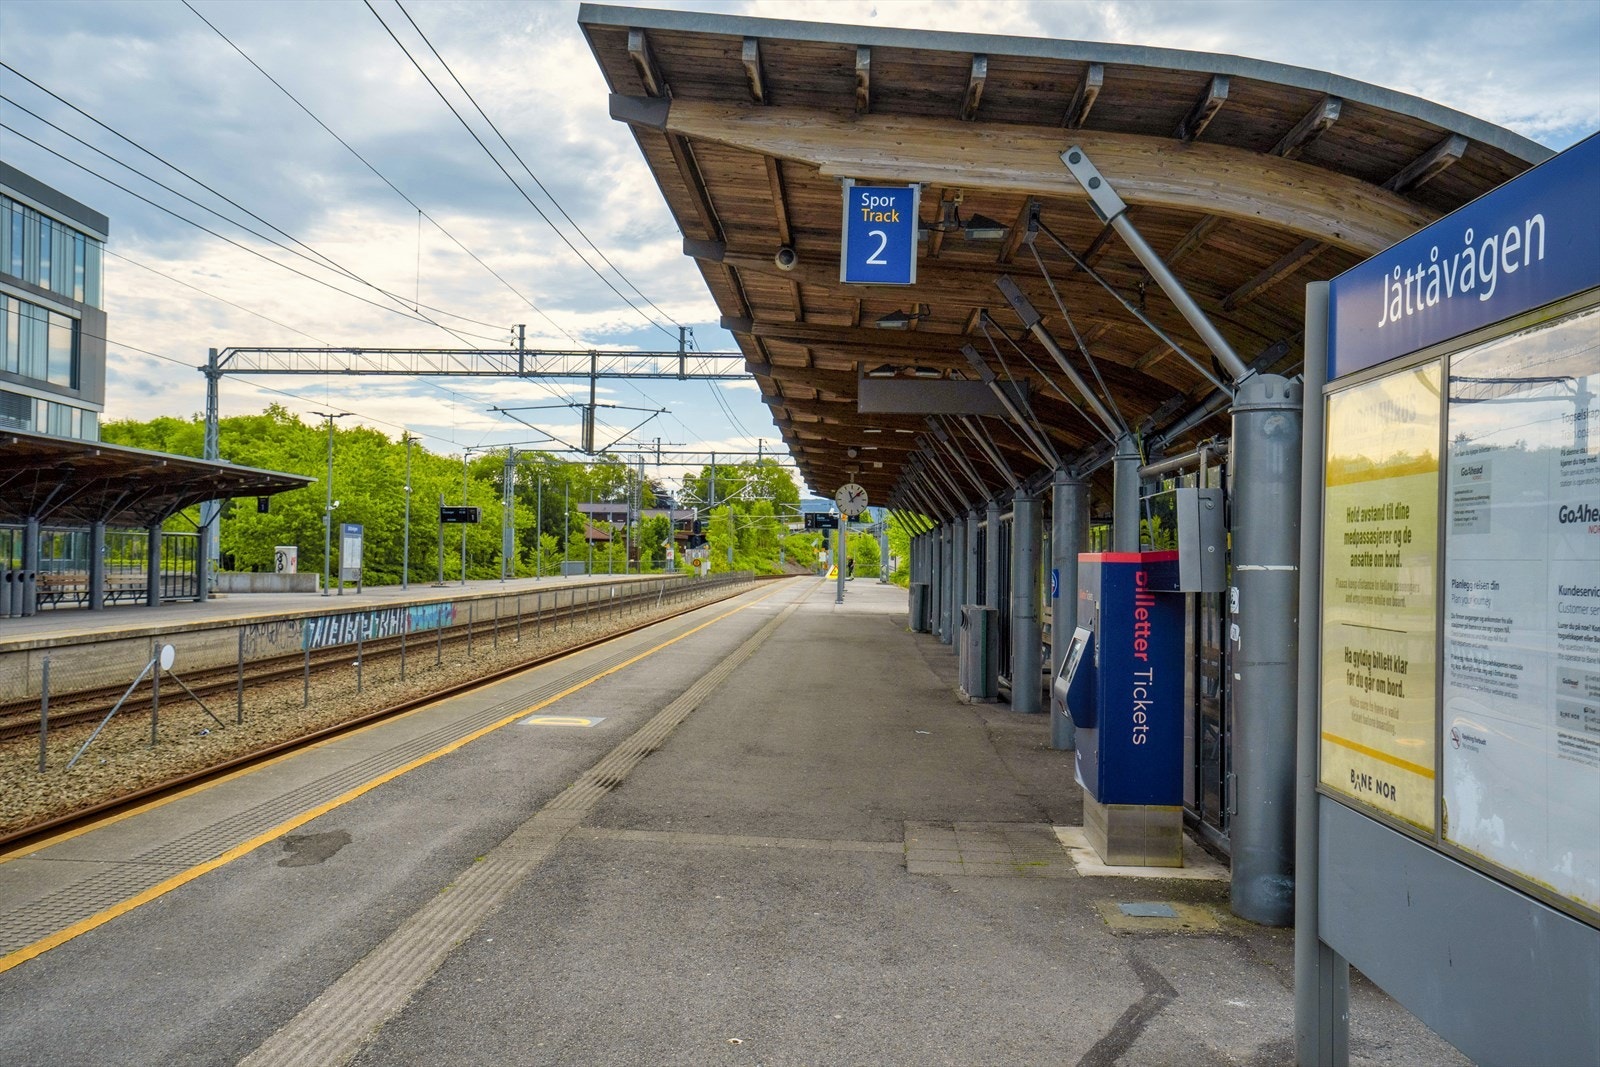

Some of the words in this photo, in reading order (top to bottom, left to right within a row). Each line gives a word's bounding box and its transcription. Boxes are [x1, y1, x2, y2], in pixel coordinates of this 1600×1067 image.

[861, 192, 896, 210] Spor
[861, 208, 900, 223] Track
[866, 230, 888, 265] 2
[1378, 213, 1546, 328] Jåttåvågen
[1346, 506, 1360, 523] Hold
[1361, 504, 1385, 522] avstand
[1386, 502, 1394, 520] til
[1395, 501, 1410, 520] dine
[1559, 503, 1600, 524] GoAhe
[1344, 527, 1392, 548] medpassasjerer
[1393, 530, 1402, 548] og
[1403, 525, 1412, 544] de
[1350, 551, 1373, 567] ansatte
[1374, 554, 1384, 567] om
[1384, 549, 1402, 568] bord.
[1558, 601, 1589, 615] Customer
[1345, 646, 1352, 663] Ha
[1353, 649, 1372, 671] gyldig
[1372, 650, 1393, 671] billett
[1394, 654, 1408, 675] klar
[1356, 671, 1364, 688] du
[1364, 671, 1375, 694] går
[1376, 678, 1386, 694] om
[1387, 677, 1405, 699] bord.
[1133, 667, 1154, 745] Tickets
[1350, 768, 1372, 793] BANE
[1375, 779, 1397, 802] NOR
